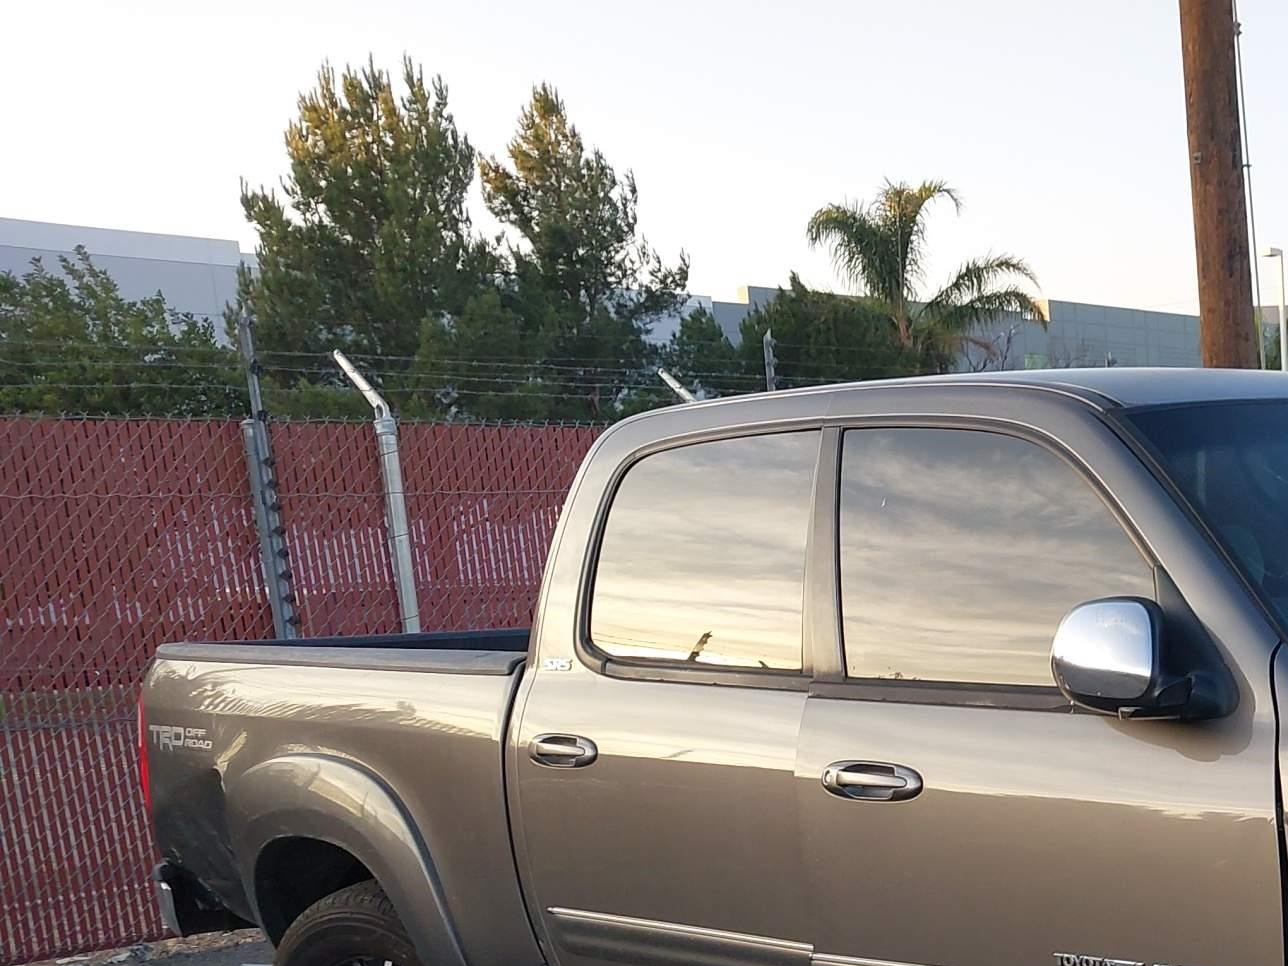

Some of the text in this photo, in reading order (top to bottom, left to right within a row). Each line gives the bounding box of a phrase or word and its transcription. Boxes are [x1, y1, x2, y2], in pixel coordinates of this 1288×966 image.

[149, 724, 207, 751] TRD OFF
[184, 738, 213, 750] ROAD
